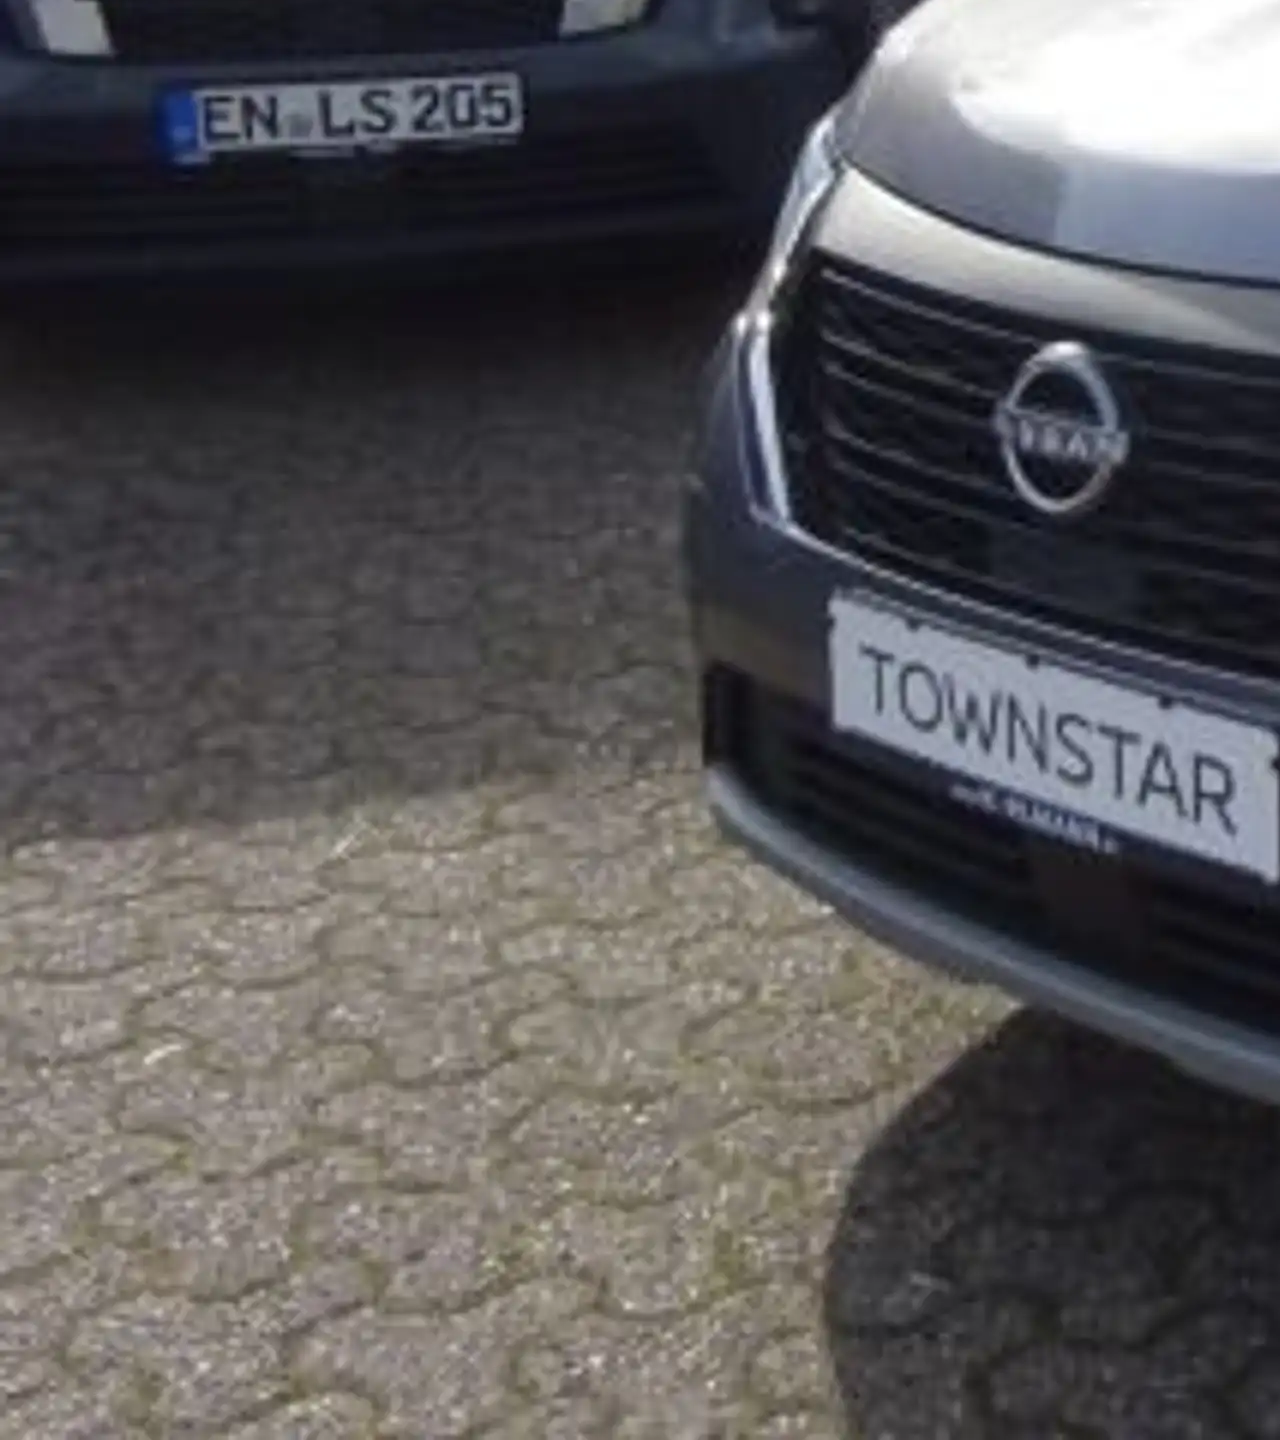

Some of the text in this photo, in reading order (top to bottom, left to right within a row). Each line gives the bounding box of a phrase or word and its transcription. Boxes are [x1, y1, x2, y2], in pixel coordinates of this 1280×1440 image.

[202, 83, 516, 140] EN LS 205
[858, 641, 1239, 838] TOWNSTAR
